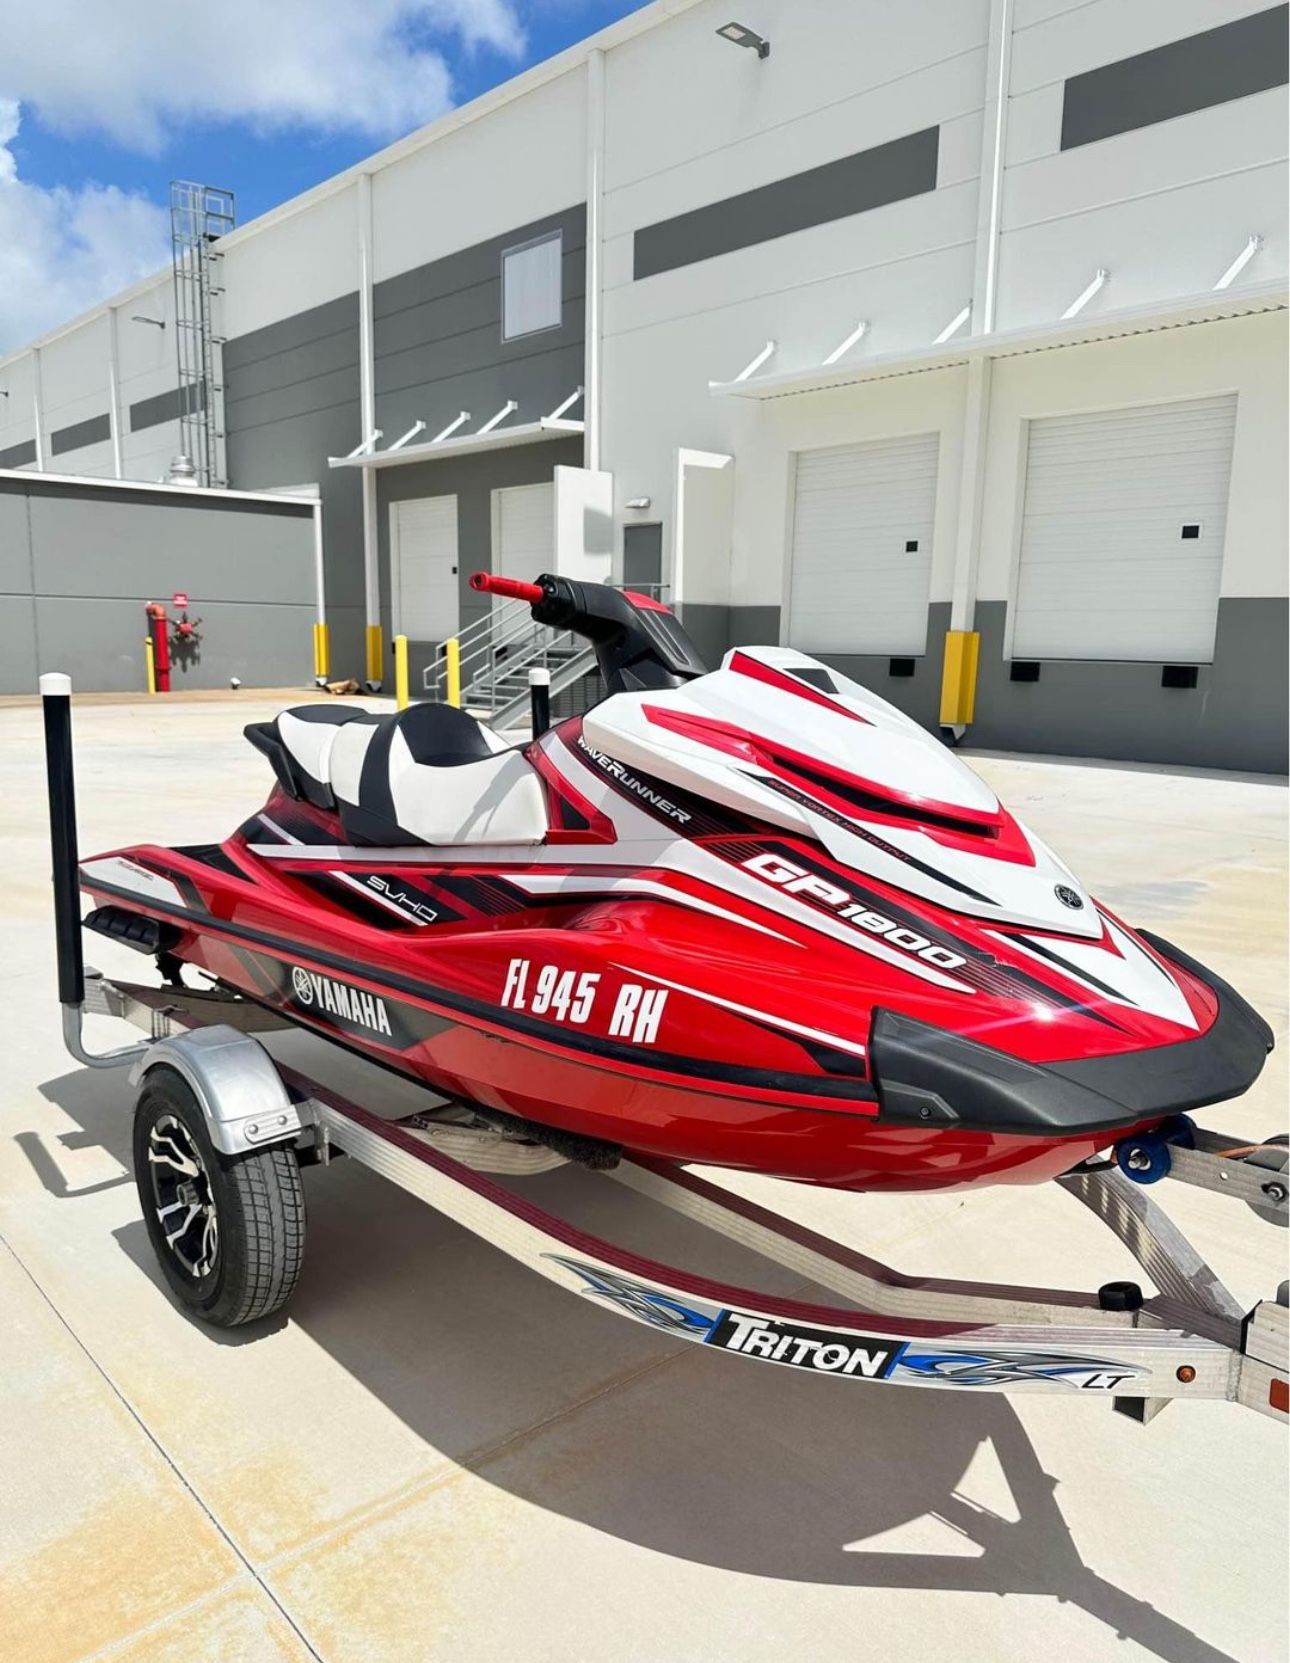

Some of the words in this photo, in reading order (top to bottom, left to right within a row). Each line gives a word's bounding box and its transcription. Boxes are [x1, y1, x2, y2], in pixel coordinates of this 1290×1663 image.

[366, 875, 438, 922] SVHO
[309, 973, 393, 1036] YAMAHA
[500, 958, 531, 1009] FL
[530, 965, 602, 1023] 945
[607, 983, 669, 1043] RH
[725, 1312, 889, 1377] TRITON
[1081, 1373, 1136, 1389] LT
